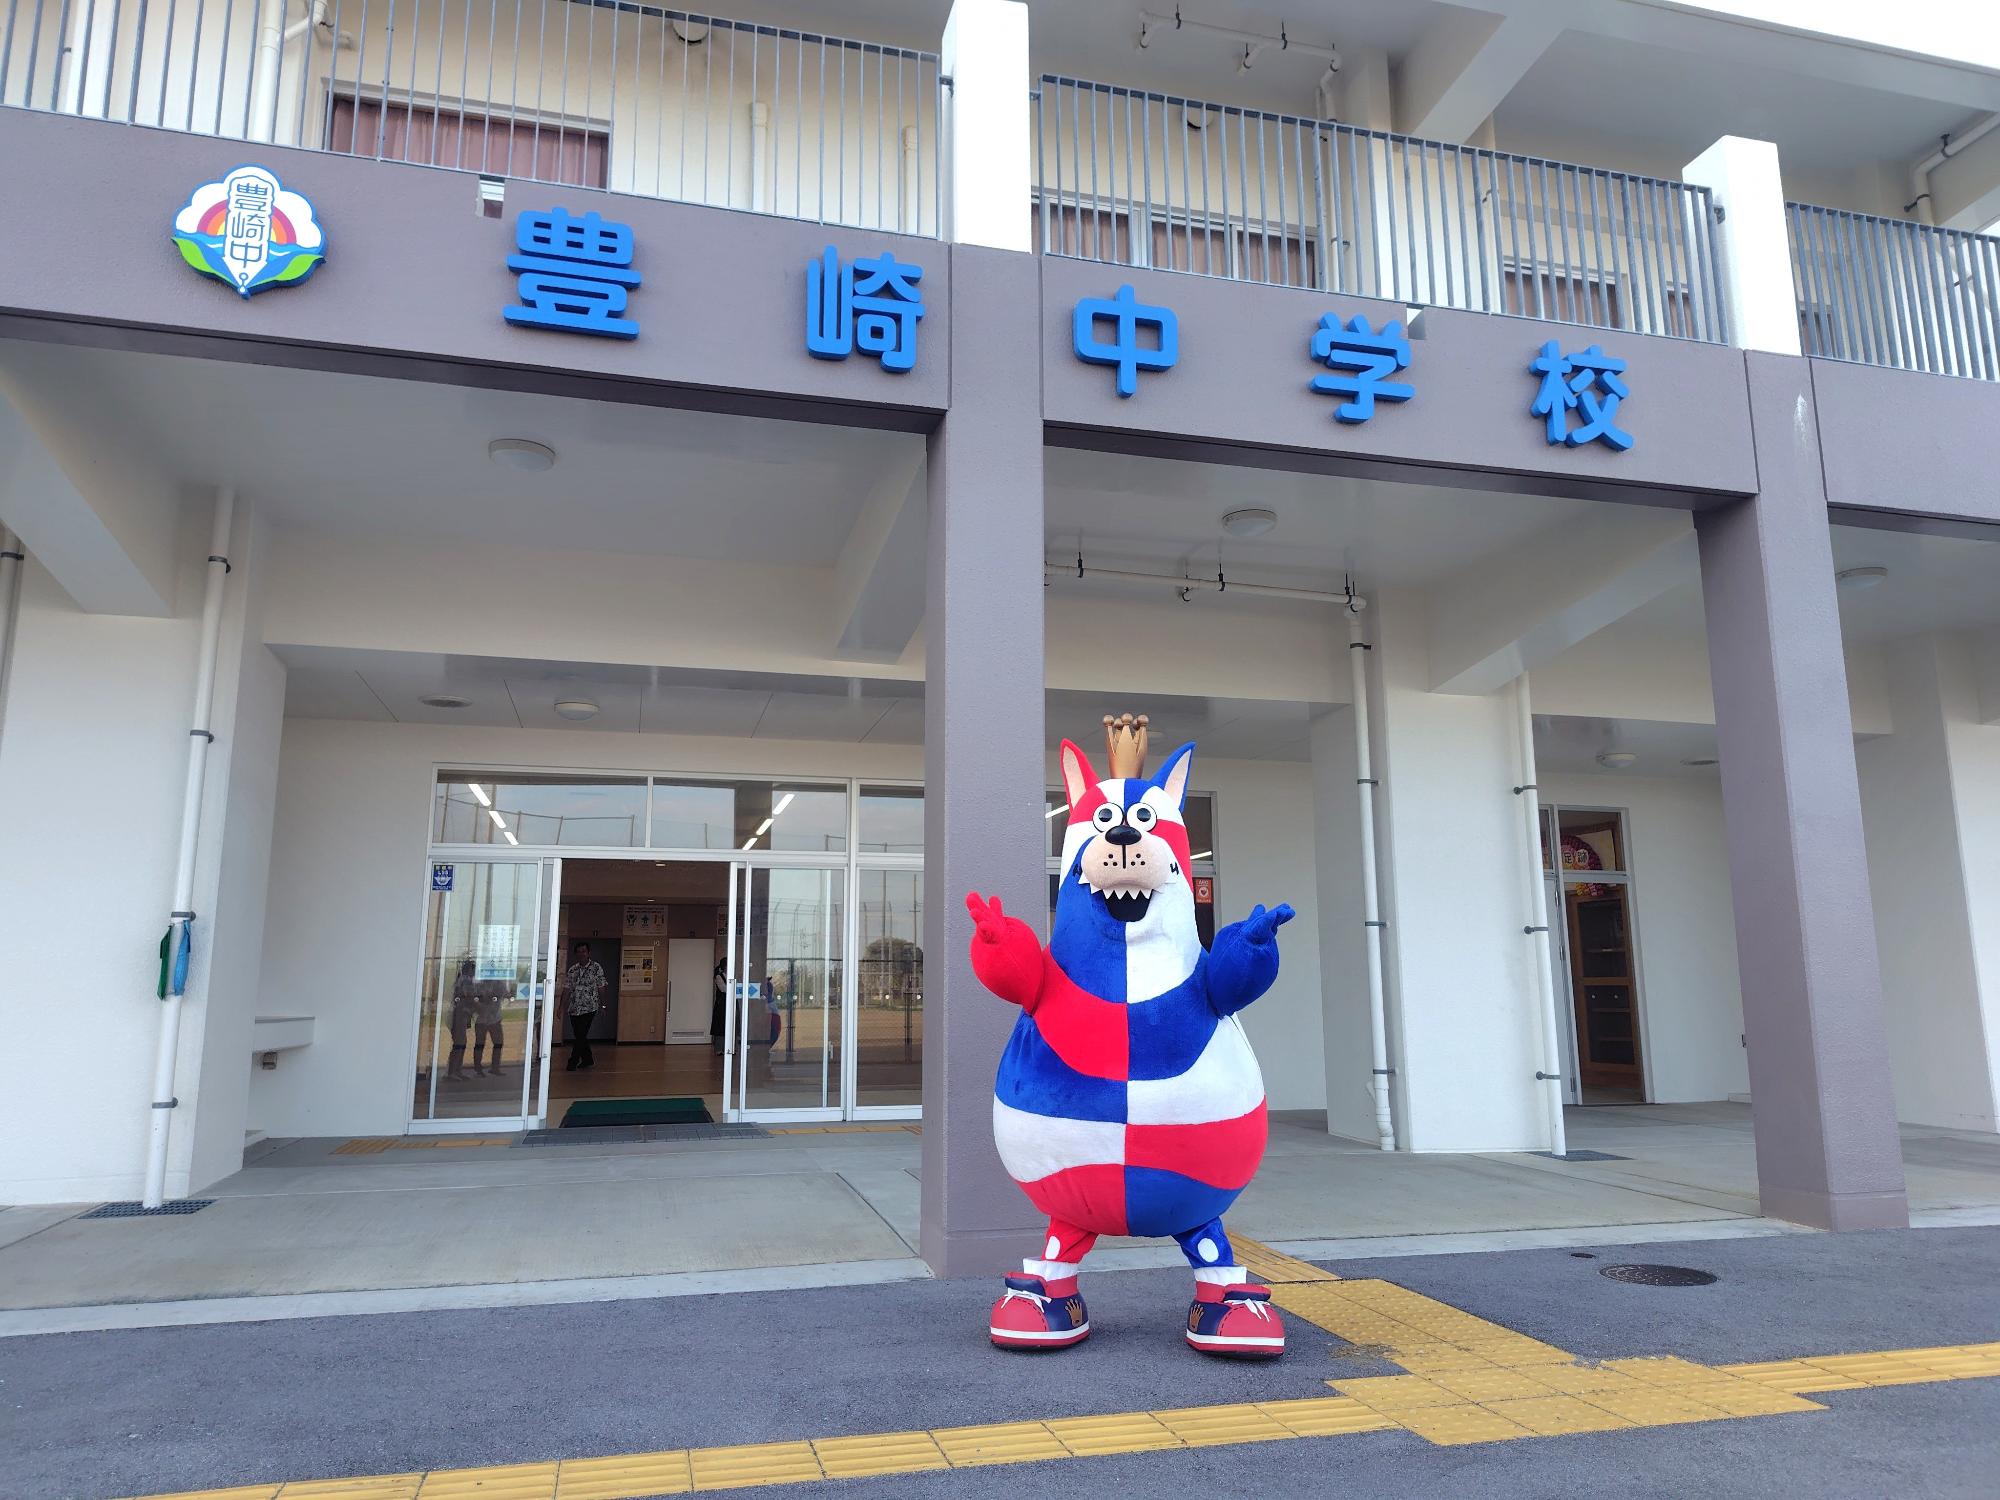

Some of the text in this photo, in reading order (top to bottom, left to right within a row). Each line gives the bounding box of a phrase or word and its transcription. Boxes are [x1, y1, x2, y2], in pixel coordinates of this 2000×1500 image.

[503, 207, 1633, 452] 豊崎中学校
